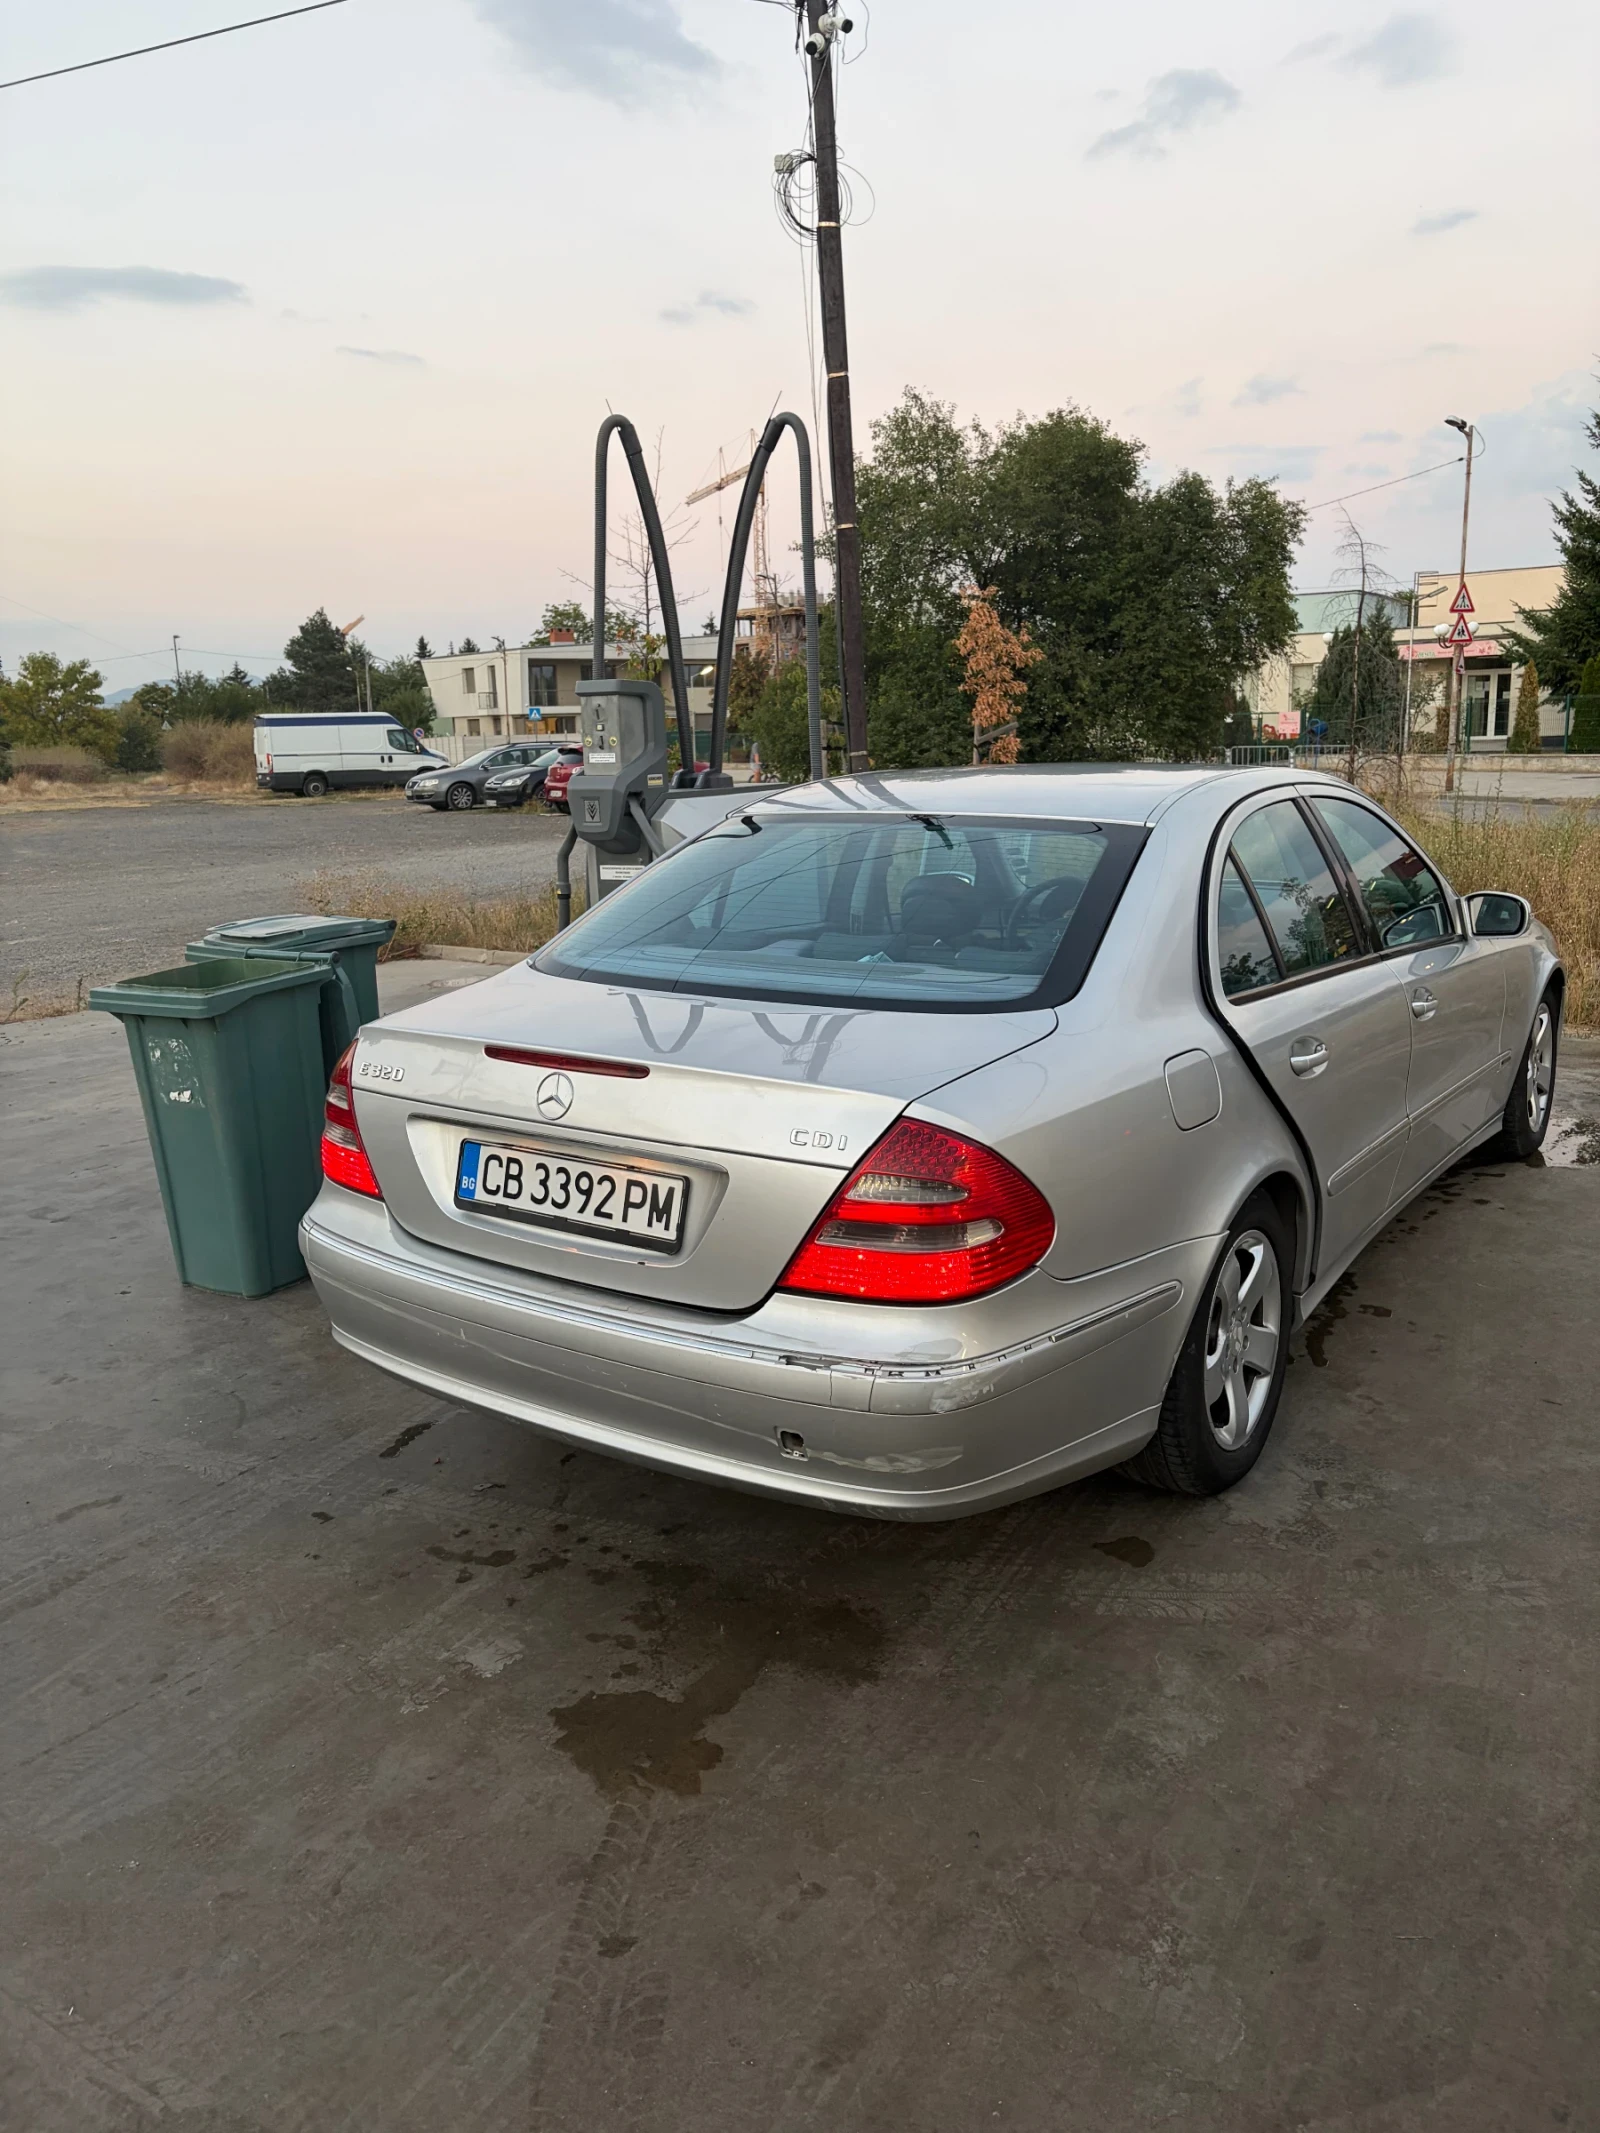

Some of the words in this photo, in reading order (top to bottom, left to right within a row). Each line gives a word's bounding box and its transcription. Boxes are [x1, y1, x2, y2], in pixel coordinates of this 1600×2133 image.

[789, 1128, 849, 1151] CDI
[461, 1175, 476, 1191] BG
[482, 1154, 524, 1200] CB
[530, 1162, 617, 1220] 3392
[621, 1178, 676, 1231] PM
